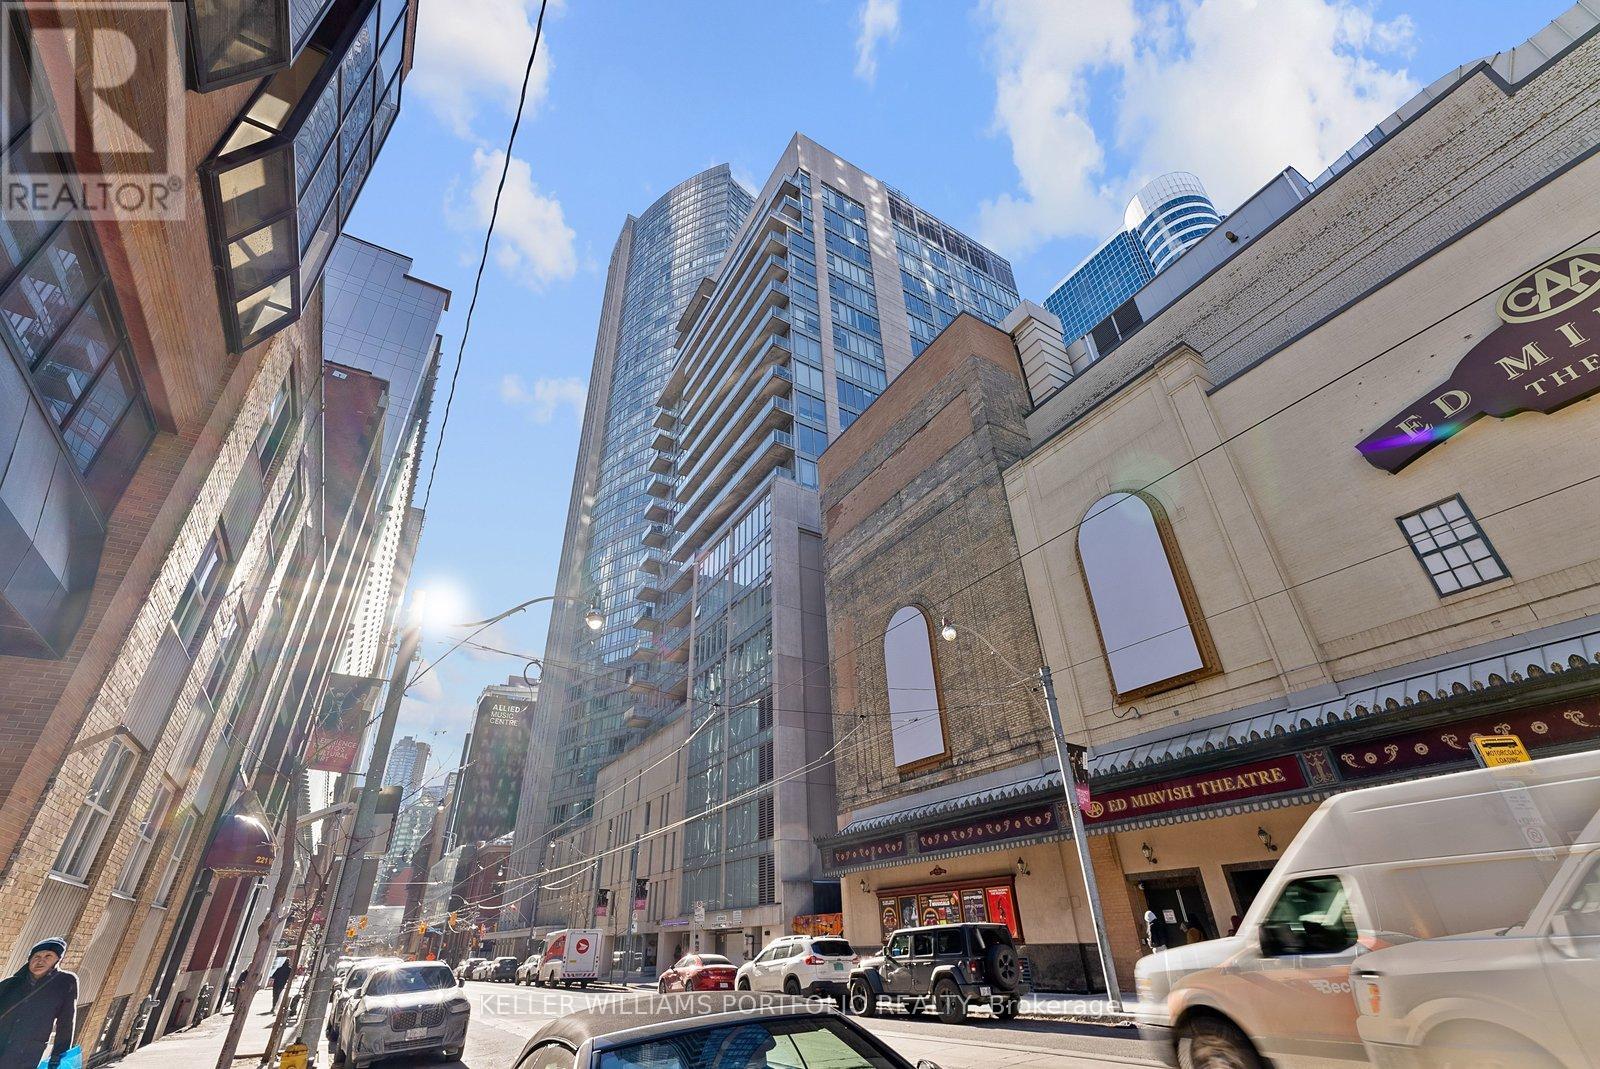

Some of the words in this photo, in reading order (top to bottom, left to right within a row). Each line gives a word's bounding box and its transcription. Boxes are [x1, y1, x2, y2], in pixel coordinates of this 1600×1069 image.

[1507, 257, 1600, 312] CAA
[1396, 389, 1472, 441] ED
[1494, 307, 1600, 381] MI
[492, 704, 521, 713] ALLIED
[490, 711, 514, 719] MUSIC
[489, 717, 518, 727] CENTRE
[1495, 756, 1521, 764] LOADING
[1107, 799, 1127, 812] ED
[1130, 784, 1194, 808] MIRVISH
[1197, 767, 1285, 796] THEATRE
